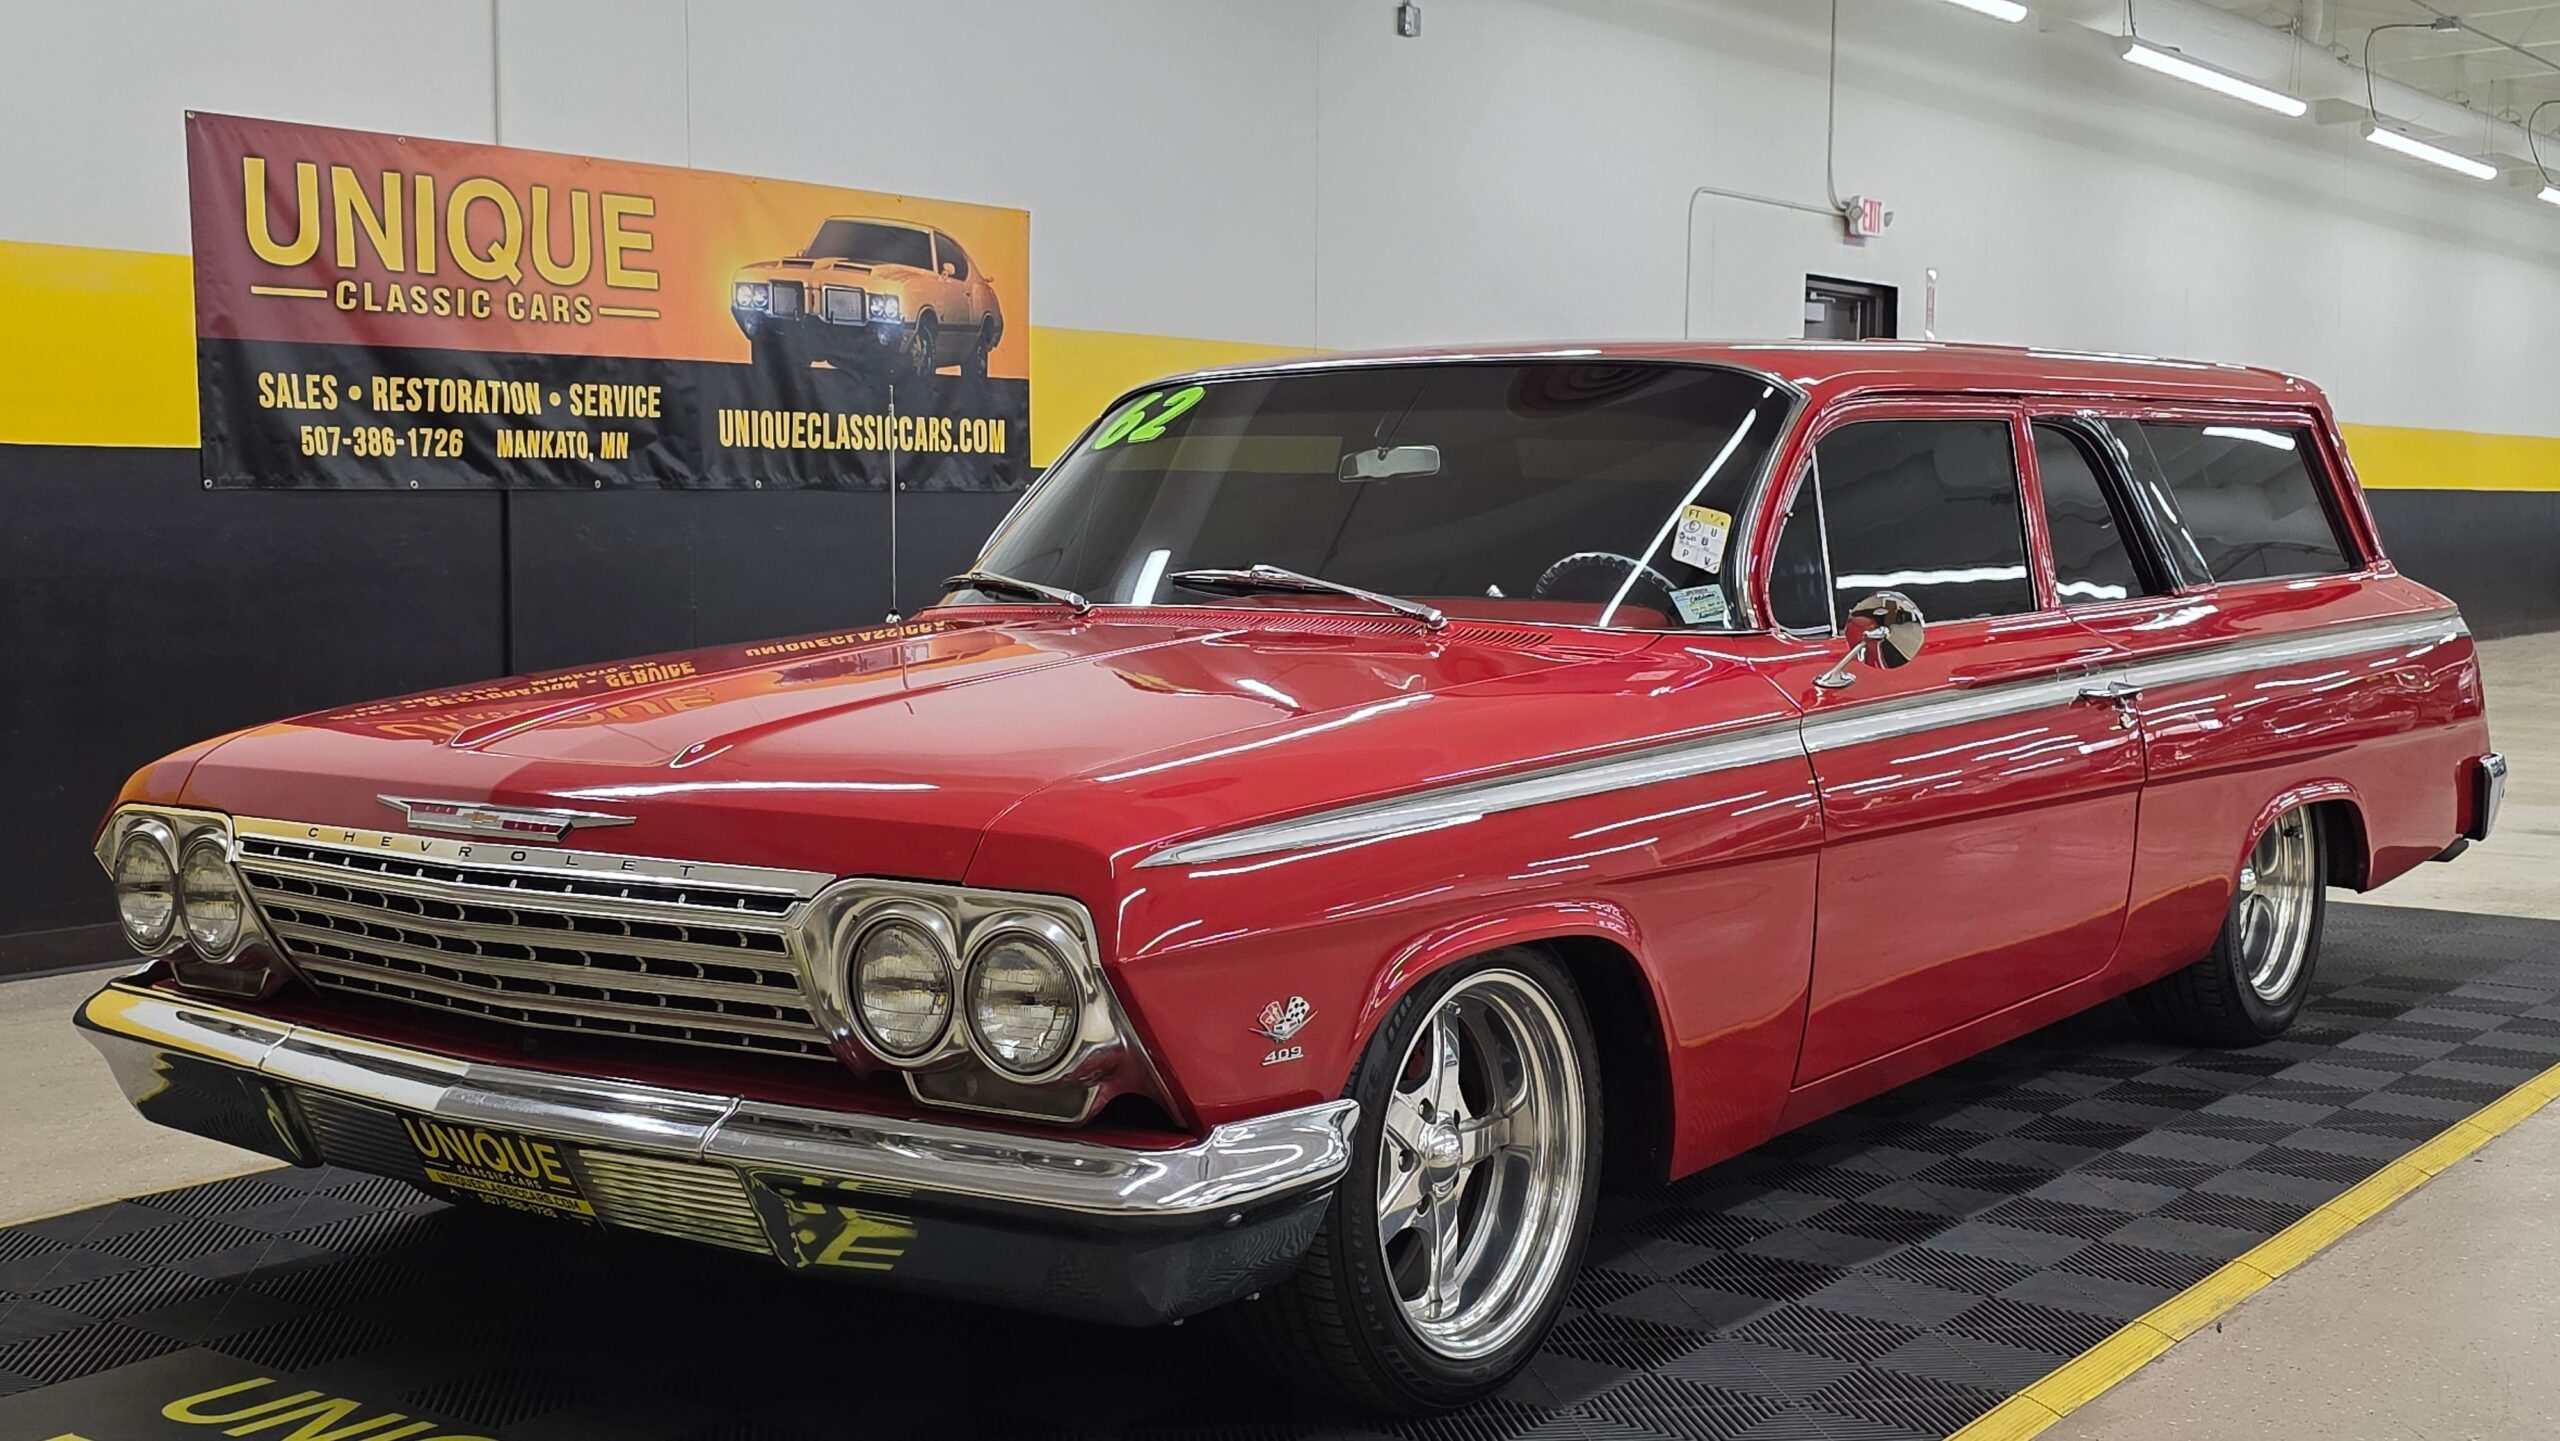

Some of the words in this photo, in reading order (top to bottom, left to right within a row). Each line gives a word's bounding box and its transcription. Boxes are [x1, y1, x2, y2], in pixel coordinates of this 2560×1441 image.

[243, 157, 660, 290] UNIQUE
[1863, 198, 1882, 234] EXIT
[336, 280, 491, 318] CLASSIC
[508, 294, 593, 324] CARS
[258, 372, 338, 410] SALES
[372, 376, 541, 415] RESTORATION
[569, 384, 662, 418] SERVICE
[718, 409, 1006, 454] UNIQUECLASSICCARS.COM
[1091, 386, 1206, 450] 62
[301, 425, 463, 458] 507-386-1726
[496, 429, 594, 462] MANKATO,
[600, 432, 629, 459] MN
[308, 827, 696, 878] CHEVROLET
[1264, 1046, 1302, 1061] 409
[402, 1117, 573, 1186] UNIQUE
[457, 1164, 507, 1183] CLASSIC
[510, 1175, 542, 1190] CARS
[161, 1376, 500, 1441] UNI
